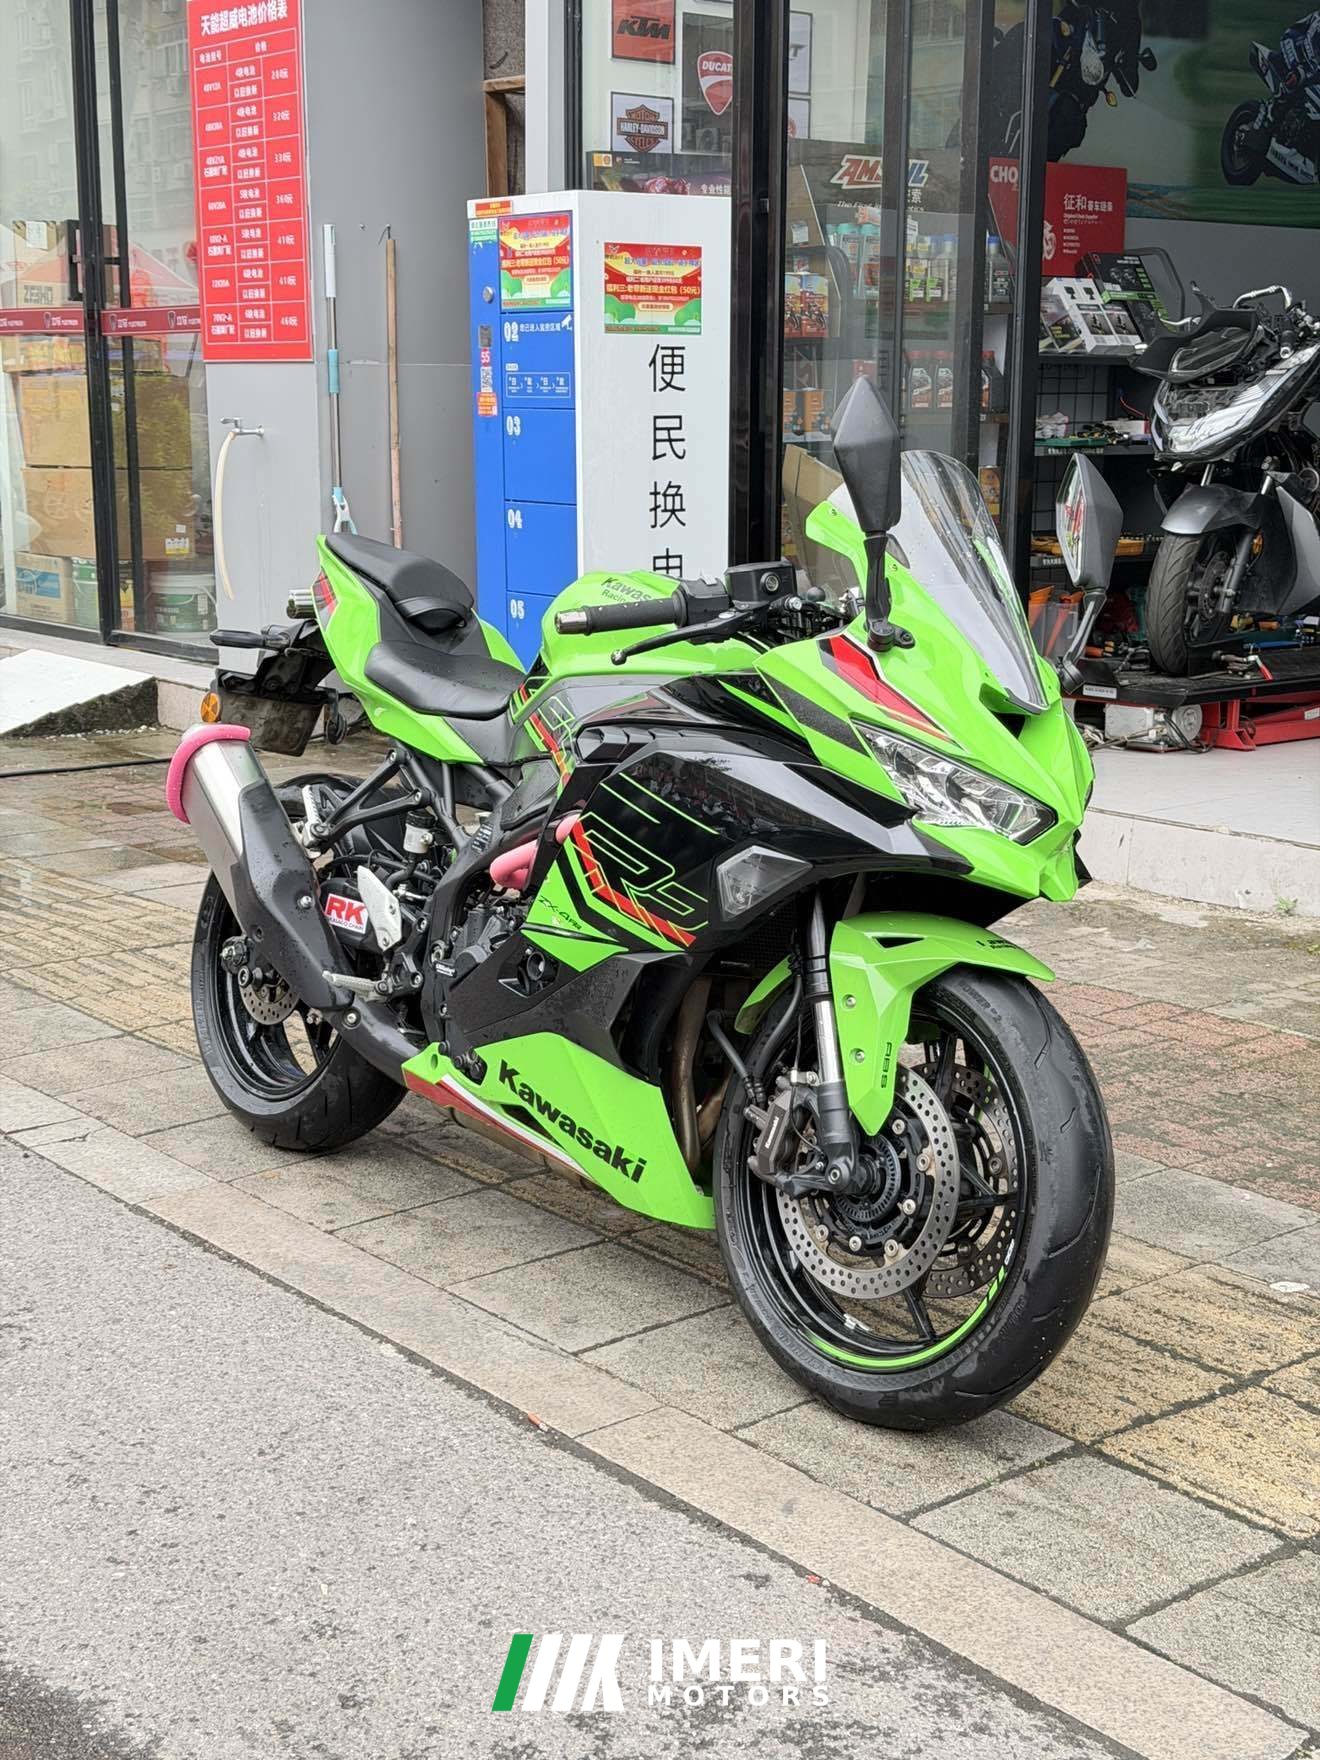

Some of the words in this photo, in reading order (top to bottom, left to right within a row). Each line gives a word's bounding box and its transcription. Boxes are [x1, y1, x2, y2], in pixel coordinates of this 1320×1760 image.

[617, 16, 671, 39] KTM
[702, 61, 732, 73] DUCAT
[990, 165, 1018, 183] CHO
[504, 321, 519, 342] 02
[506, 415, 521, 435] 03
[507, 509, 523, 529] 04
[601, 577, 652, 600] Kawas
[601, 589, 626, 602] Racin
[510, 599, 524, 619] 05
[327, 896, 367, 925] RK
[881, 1042, 892, 1088] ABS
[499, 1059, 647, 1183] Kawasaki
